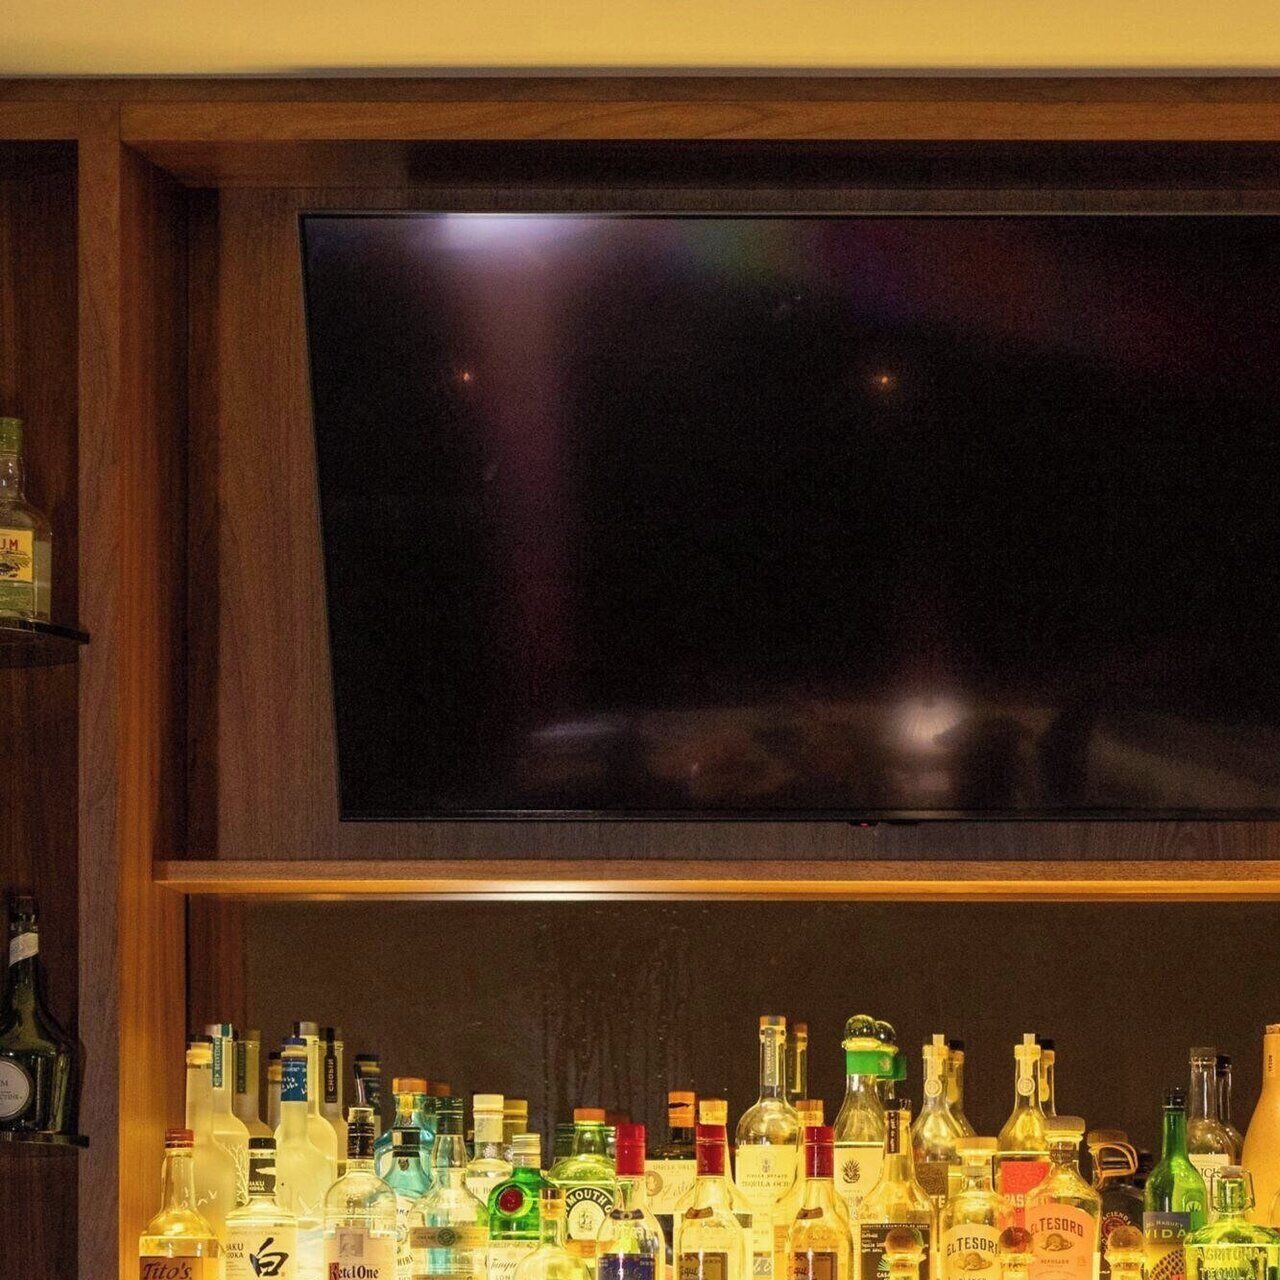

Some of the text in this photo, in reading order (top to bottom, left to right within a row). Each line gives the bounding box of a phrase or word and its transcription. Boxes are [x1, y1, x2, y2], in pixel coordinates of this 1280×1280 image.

[1040, 1217, 1084, 1238] TESORO
[249, 1237, 289, 1278] 白
[144, 1261, 192, 1280] Tito's
[357, 1266, 379, 1279] One
